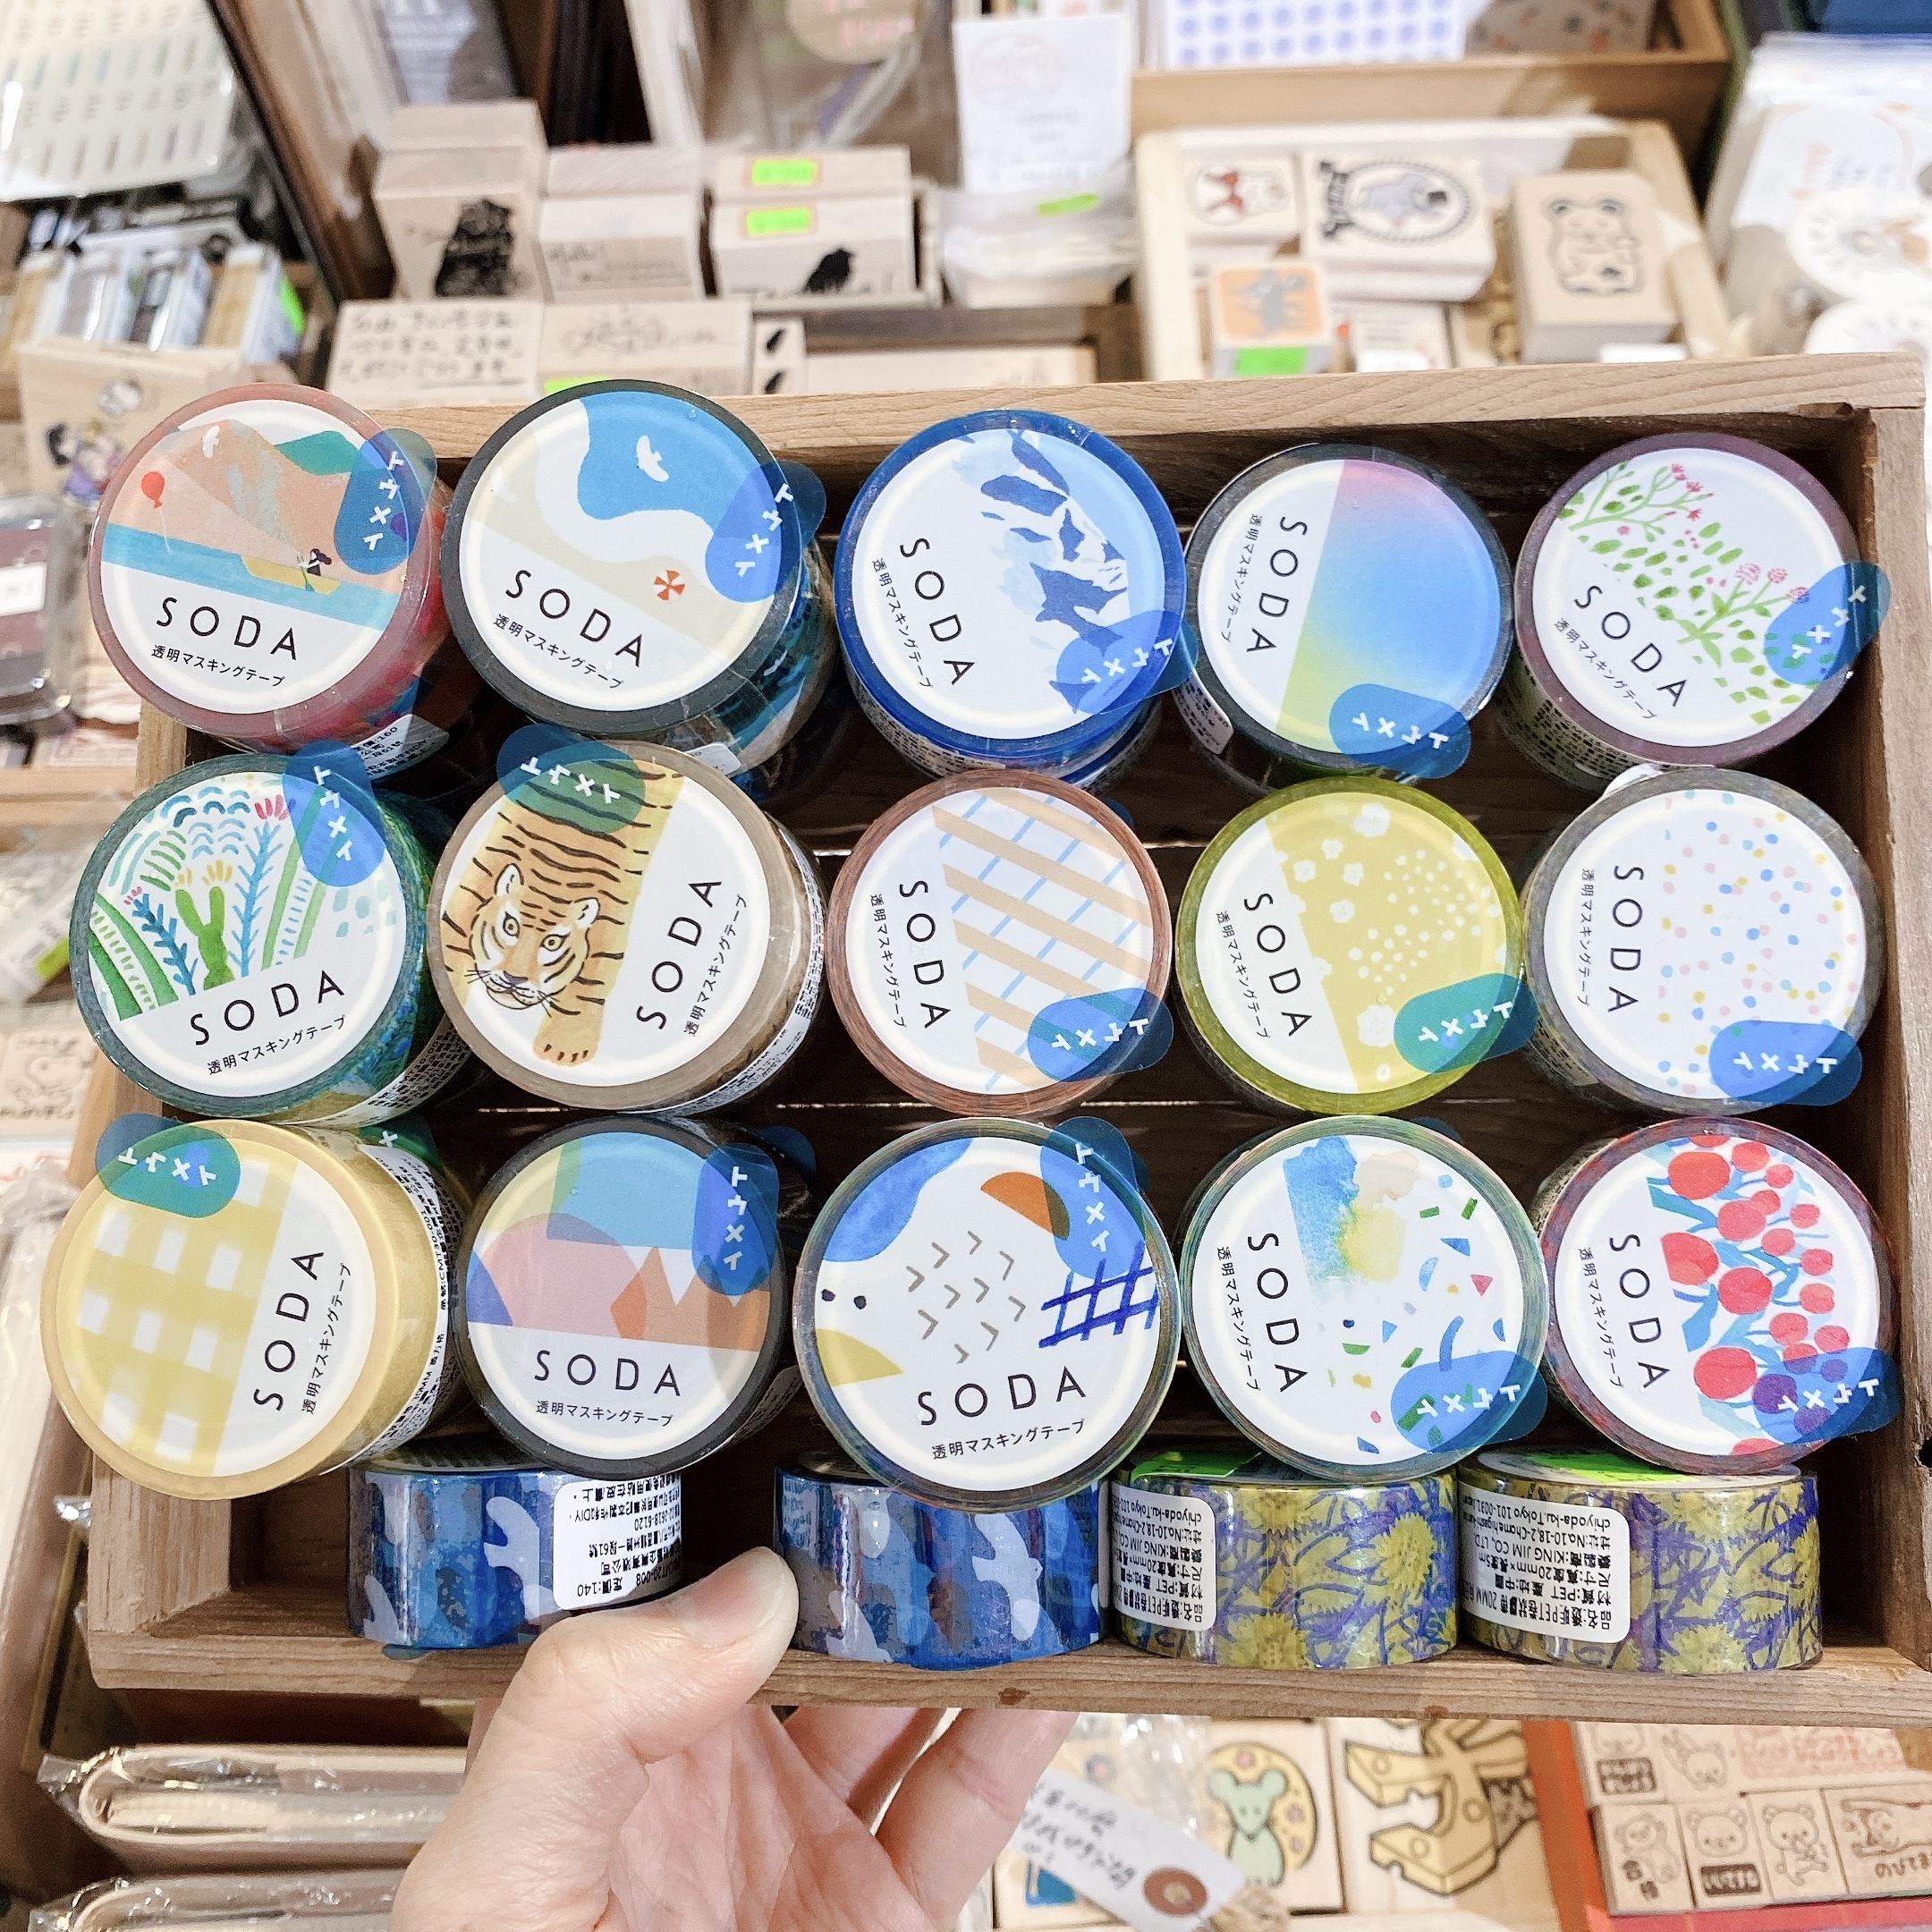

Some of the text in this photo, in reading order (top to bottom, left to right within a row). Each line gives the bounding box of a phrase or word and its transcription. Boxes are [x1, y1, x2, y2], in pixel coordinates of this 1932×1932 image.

[363, 452, 404, 551] トウメイ
[735, 483, 793, 577] トウメイ
[505, 570, 643, 667] SODA
[871, 558, 934, 689] 透明マスキングテープ
[900, 538, 976, 685] SODA
[1221, 513, 1263, 642] 透明マスキングテープ
[1246, 517, 1308, 652] SODA
[1792, 585, 1867, 658] トウメイ
[151, 645, 285, 688] 透明マスキングテープ
[157, 597, 298, 660] SODA
[494, 613, 625, 689] 透明マスキングテープ
[1081, 638, 1174, 683] トウメイ
[1555, 619, 1657, 719] 透明マスキングテープ
[1574, 585, 1687, 706] SODA
[1352, 712, 1449, 749] トウメイ
[314, 766, 352, 860] トウメイ
[521, 756, 621, 803] トウメイ
[636, 880, 722, 1030] SODA
[683, 894, 749, 1036] 透明マスキングテープ
[869, 894, 907, 1028] 透明マスキングテープ
[899, 880, 951, 1029] SODA
[1216, 911, 1271, 1039] 透明マスキングテープ
[1243, 893, 1312, 1037] SODA
[1578, 869, 1594, 1006] 透明マスキングテープ
[1607, 866, 1644, 1013] SODA
[191, 970, 344, 1046] SODA
[208, 1014, 346, 1075] 透明マスキングテープ
[1051, 1019, 1149, 1050] トウメイ
[1418, 1002, 1513, 1042] トウメイ
[1733, 1051, 1837, 1073] トウメイ
[118, 1147, 216, 1187] トウメイ
[1075, 1144, 1108, 1252] トウメイ
[723, 1165, 748, 1270] トウメイ
[253, 1251, 324, 1411] SODA
[301, 1263, 352, 1414] 透明マスキングテープ
[1217, 1246, 1261, 1392] 透明マスキングテープ
[1247, 1233, 1308, 1392] SODA
[1579, 1248, 1623, 1387] 透明マスキングテープ
[1609, 1234, 1670, 1388] SODA
[535, 1350, 682, 1396] SODA
[535, 1400, 674, 1427] 透明マスキングテープ
[918, 1366, 1086, 1426] SODA
[1417, 1384, 1521, 1418] トウメイ
[1777, 1377, 1879, 1411] トウメイ
[932, 1419, 1085, 1459] 透明マスキングテープ
[577, 1577, 623, 1597] 定價:140
[1513, 1544, 1530, 1558] JIM
